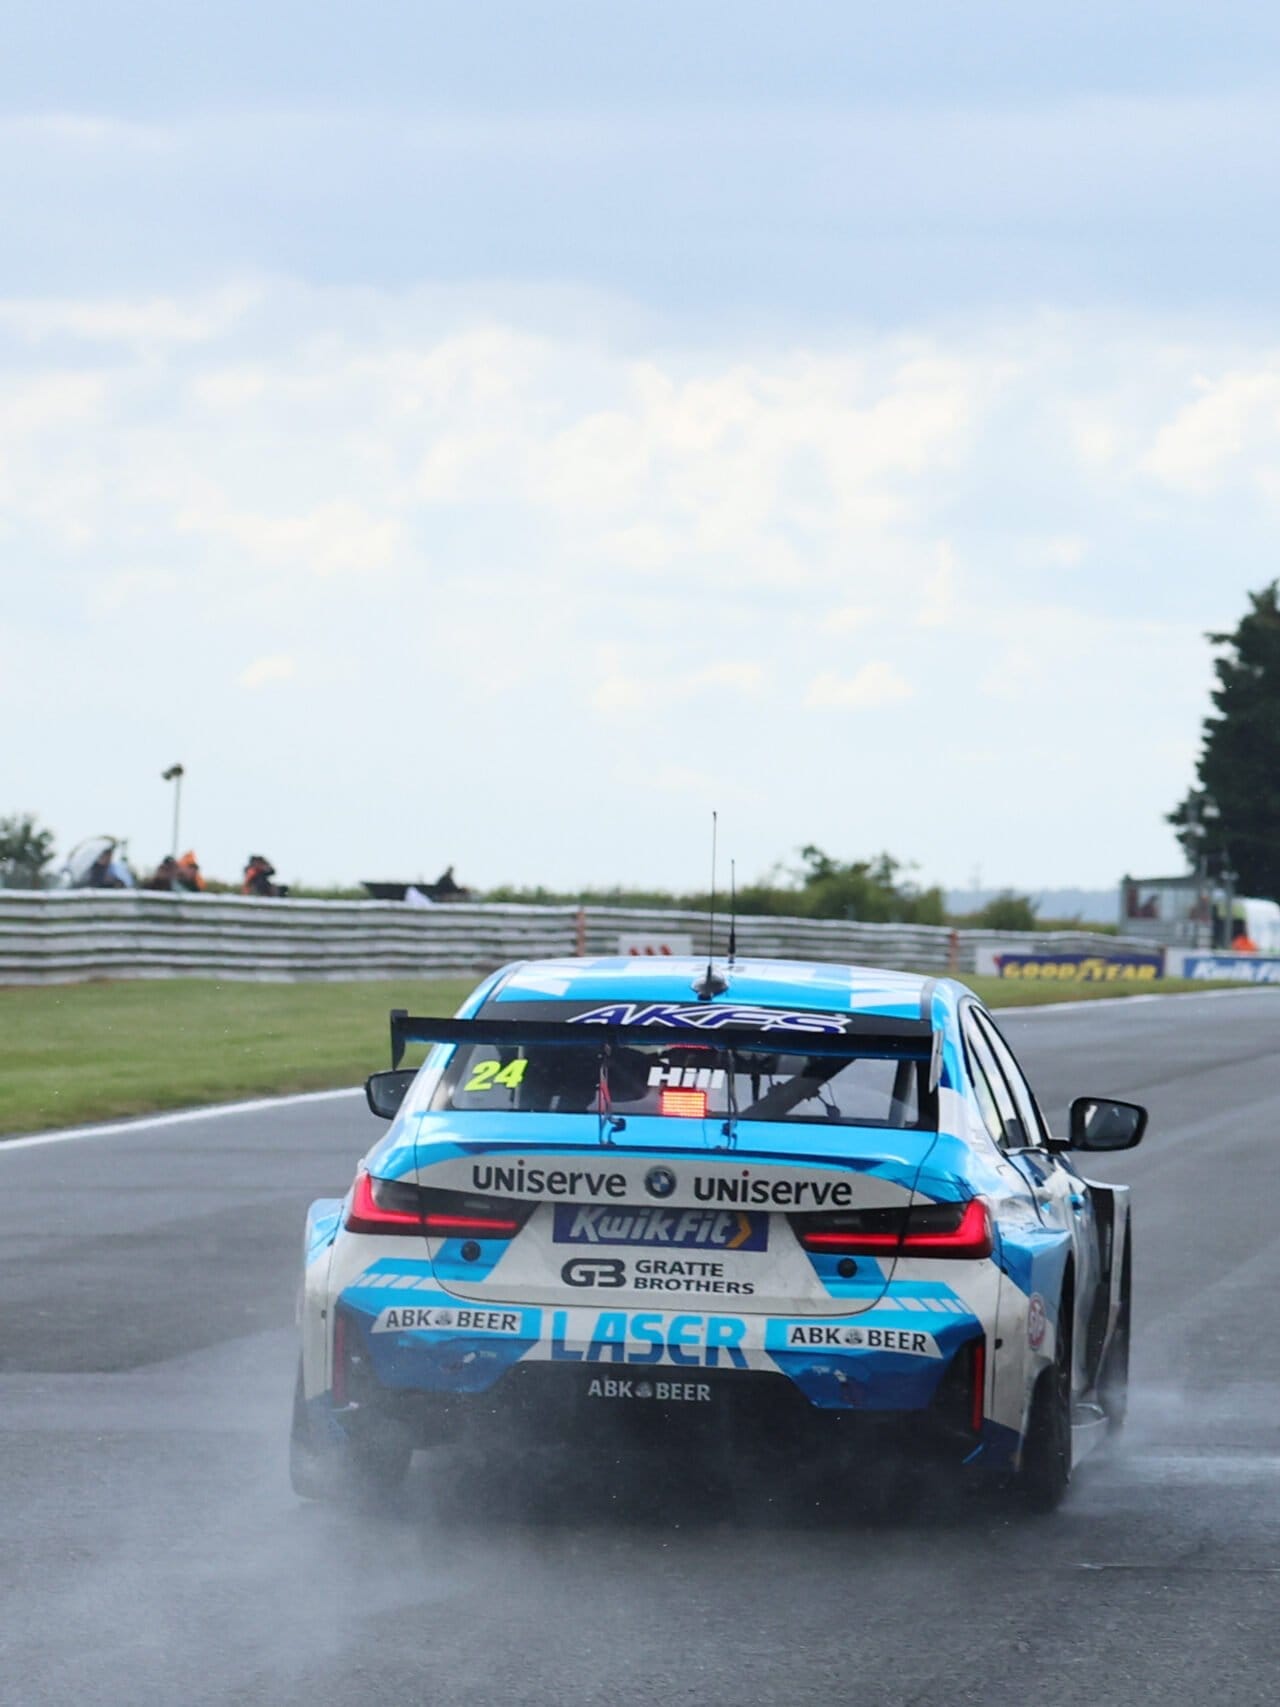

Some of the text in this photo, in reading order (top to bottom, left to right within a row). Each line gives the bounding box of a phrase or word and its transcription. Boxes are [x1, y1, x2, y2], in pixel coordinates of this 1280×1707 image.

[464, 1058, 528, 1092] 24
[647, 1066, 726, 1089] Hill
[561, 1257, 627, 1288] GB
[634, 1259, 724, 1277] GRATTE
[633, 1277, 755, 1295] BROTHERS
[386, 1309, 517, 1331] ABK BEER
[551, 1310, 749, 1369] LASER
[790, 1326, 927, 1353] ABK BEER
[588, 1380, 711, 1401] ABK BEER
